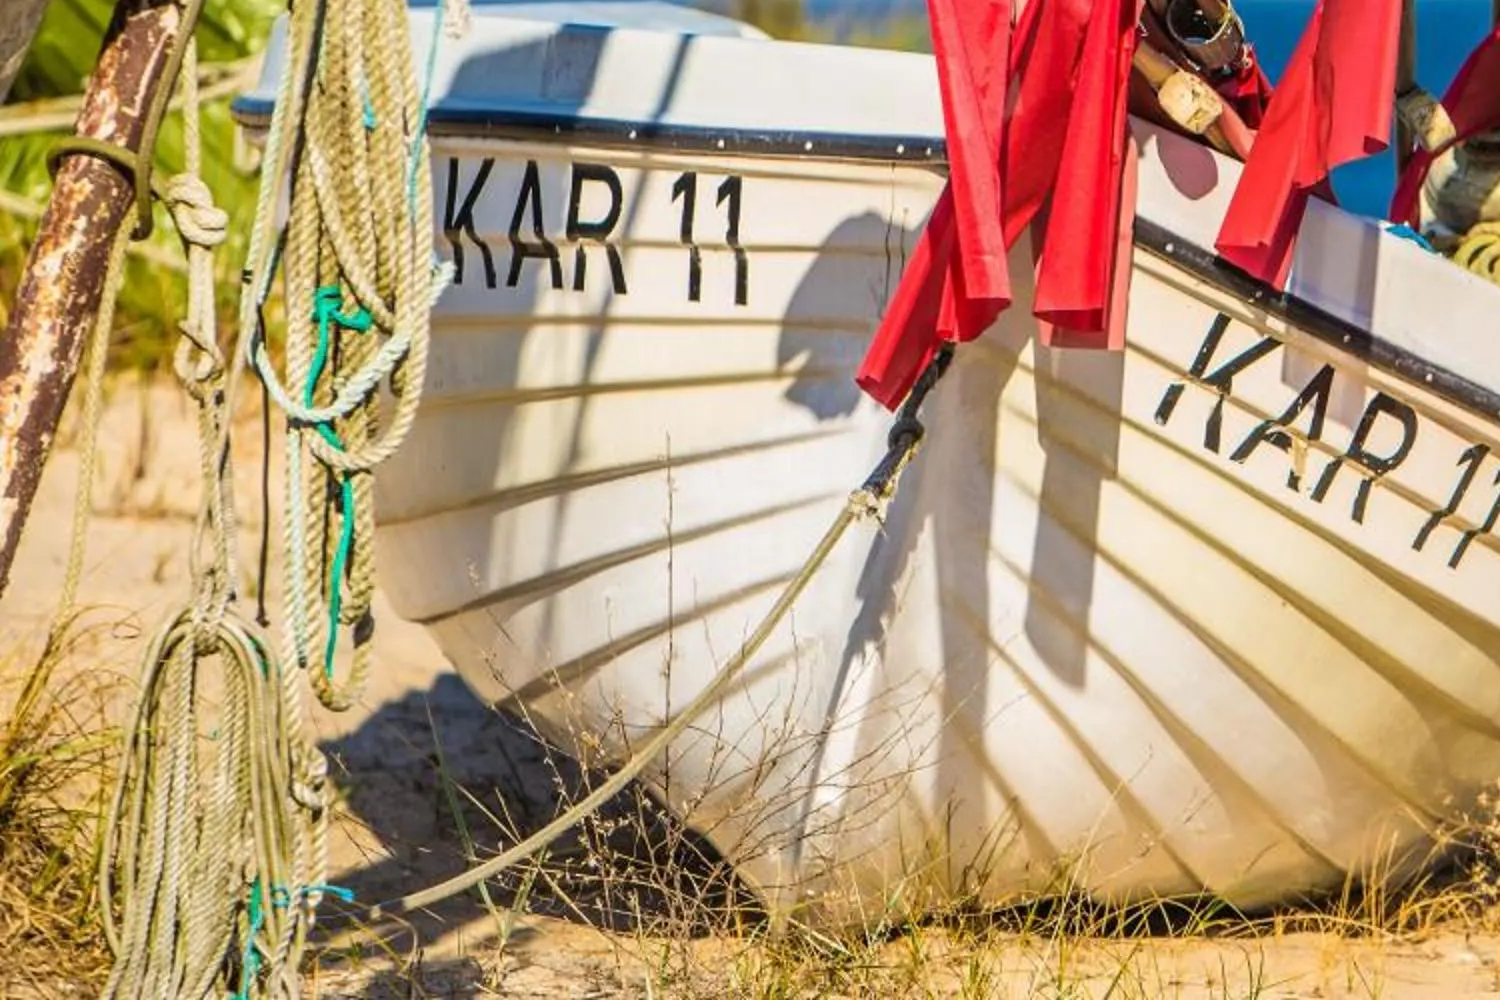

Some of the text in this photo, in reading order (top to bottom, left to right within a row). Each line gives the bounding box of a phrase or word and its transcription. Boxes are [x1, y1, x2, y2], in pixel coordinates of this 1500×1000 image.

[444, 157, 748, 306] KAR 11
[1154, 313, 1418, 524] KAR
